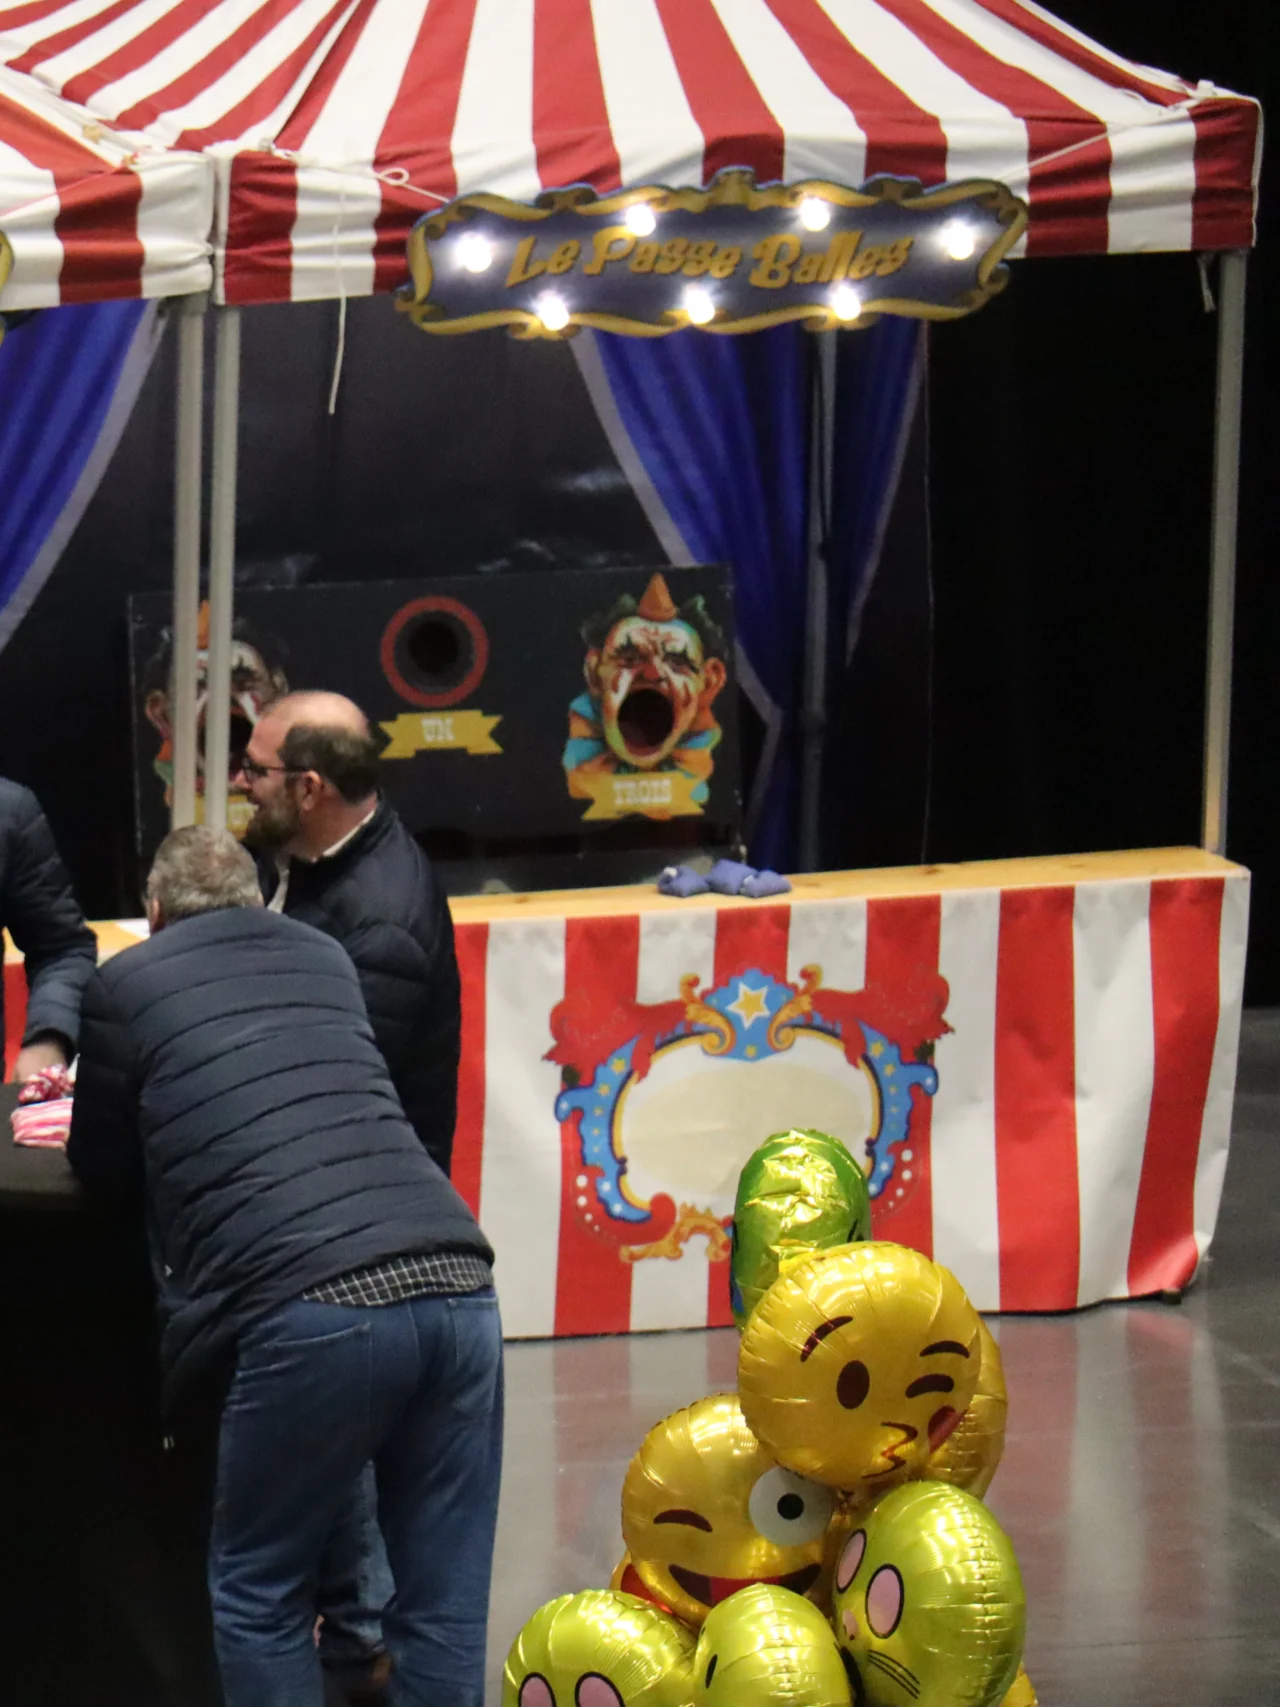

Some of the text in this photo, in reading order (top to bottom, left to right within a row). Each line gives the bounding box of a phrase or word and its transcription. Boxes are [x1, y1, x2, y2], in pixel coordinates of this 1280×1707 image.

[506, 225, 914, 289] Le Passe Balles
